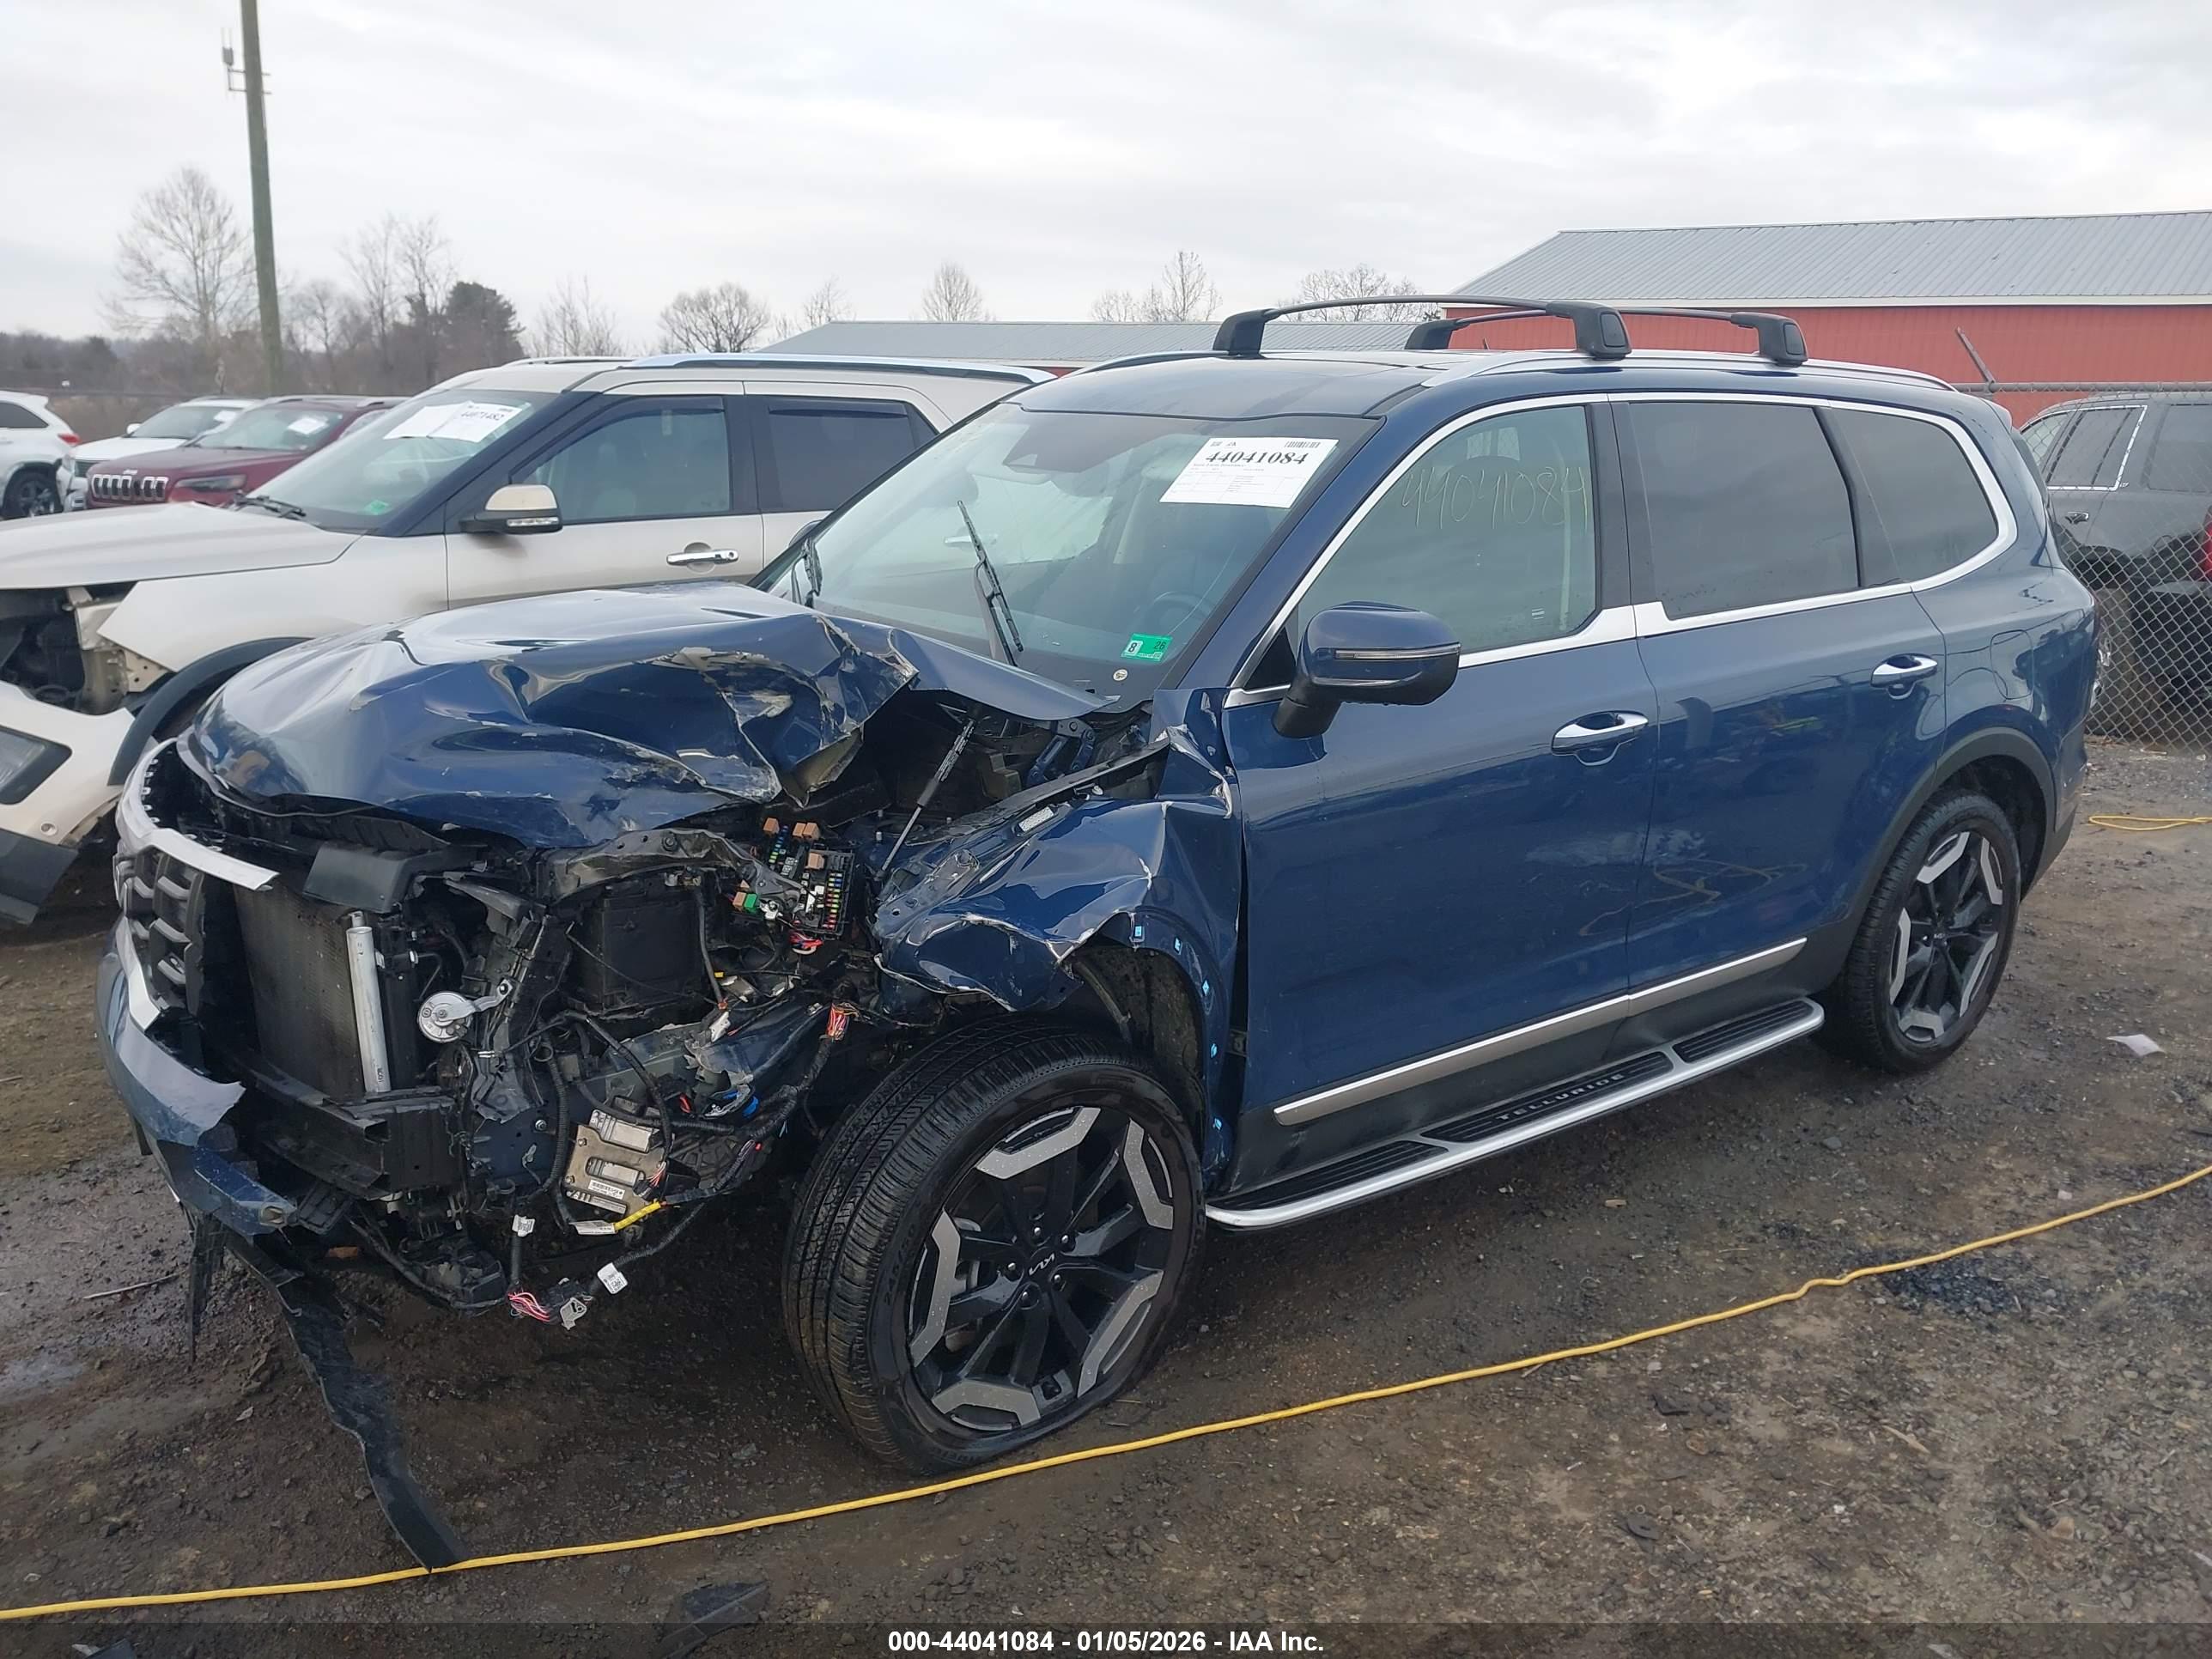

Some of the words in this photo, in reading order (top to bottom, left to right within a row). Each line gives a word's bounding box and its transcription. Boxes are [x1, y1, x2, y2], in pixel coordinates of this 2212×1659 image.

[1205, 451, 1310, 465] 44041084
[1127, 641, 1138, 653] 8
[1153, 641, 1167, 650] 26
[1495, 1073, 1625, 1121] TELLURIDE
